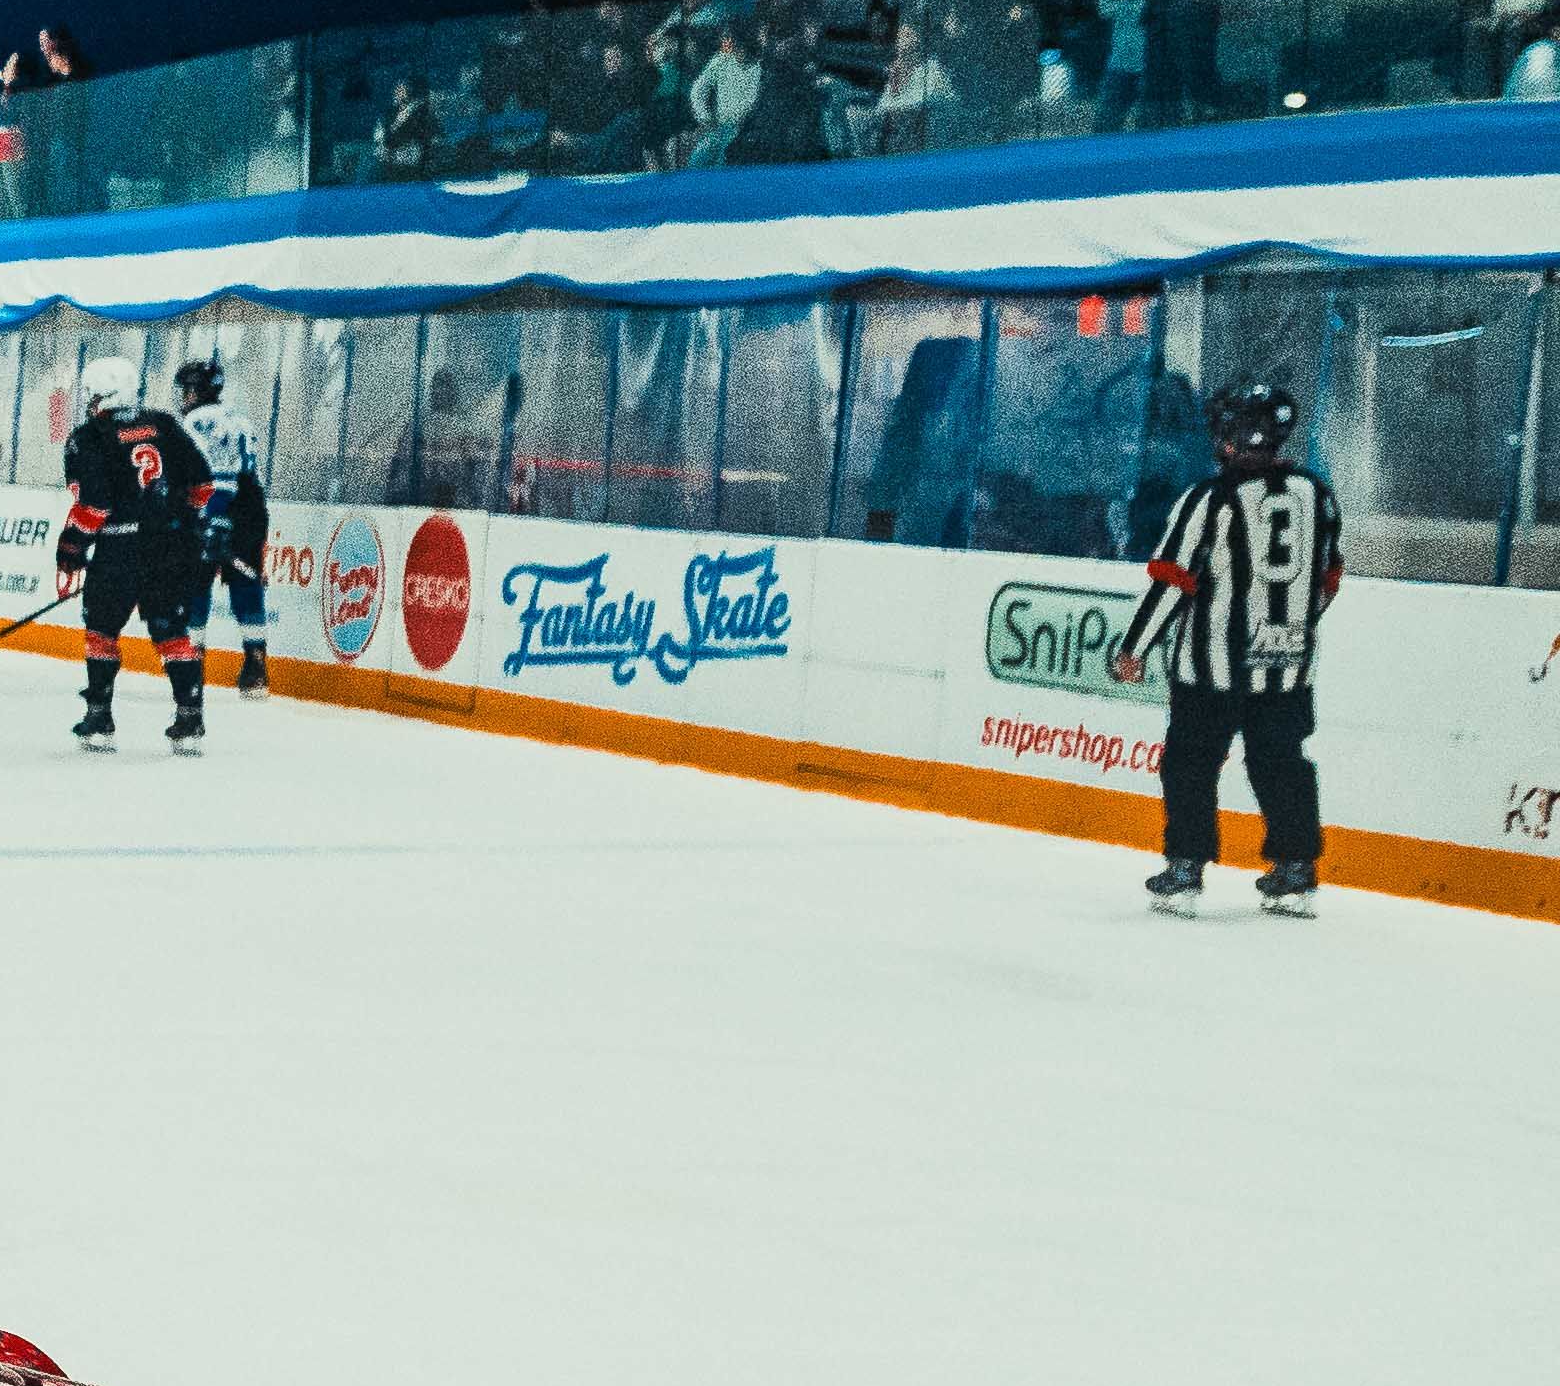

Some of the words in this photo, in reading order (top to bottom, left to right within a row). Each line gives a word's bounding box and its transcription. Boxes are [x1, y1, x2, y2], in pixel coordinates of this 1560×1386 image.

[502, 551, 657, 687] Fantasy
[652, 544, 792, 685] Skate
[981, 713, 1165, 774] snipershop.co
